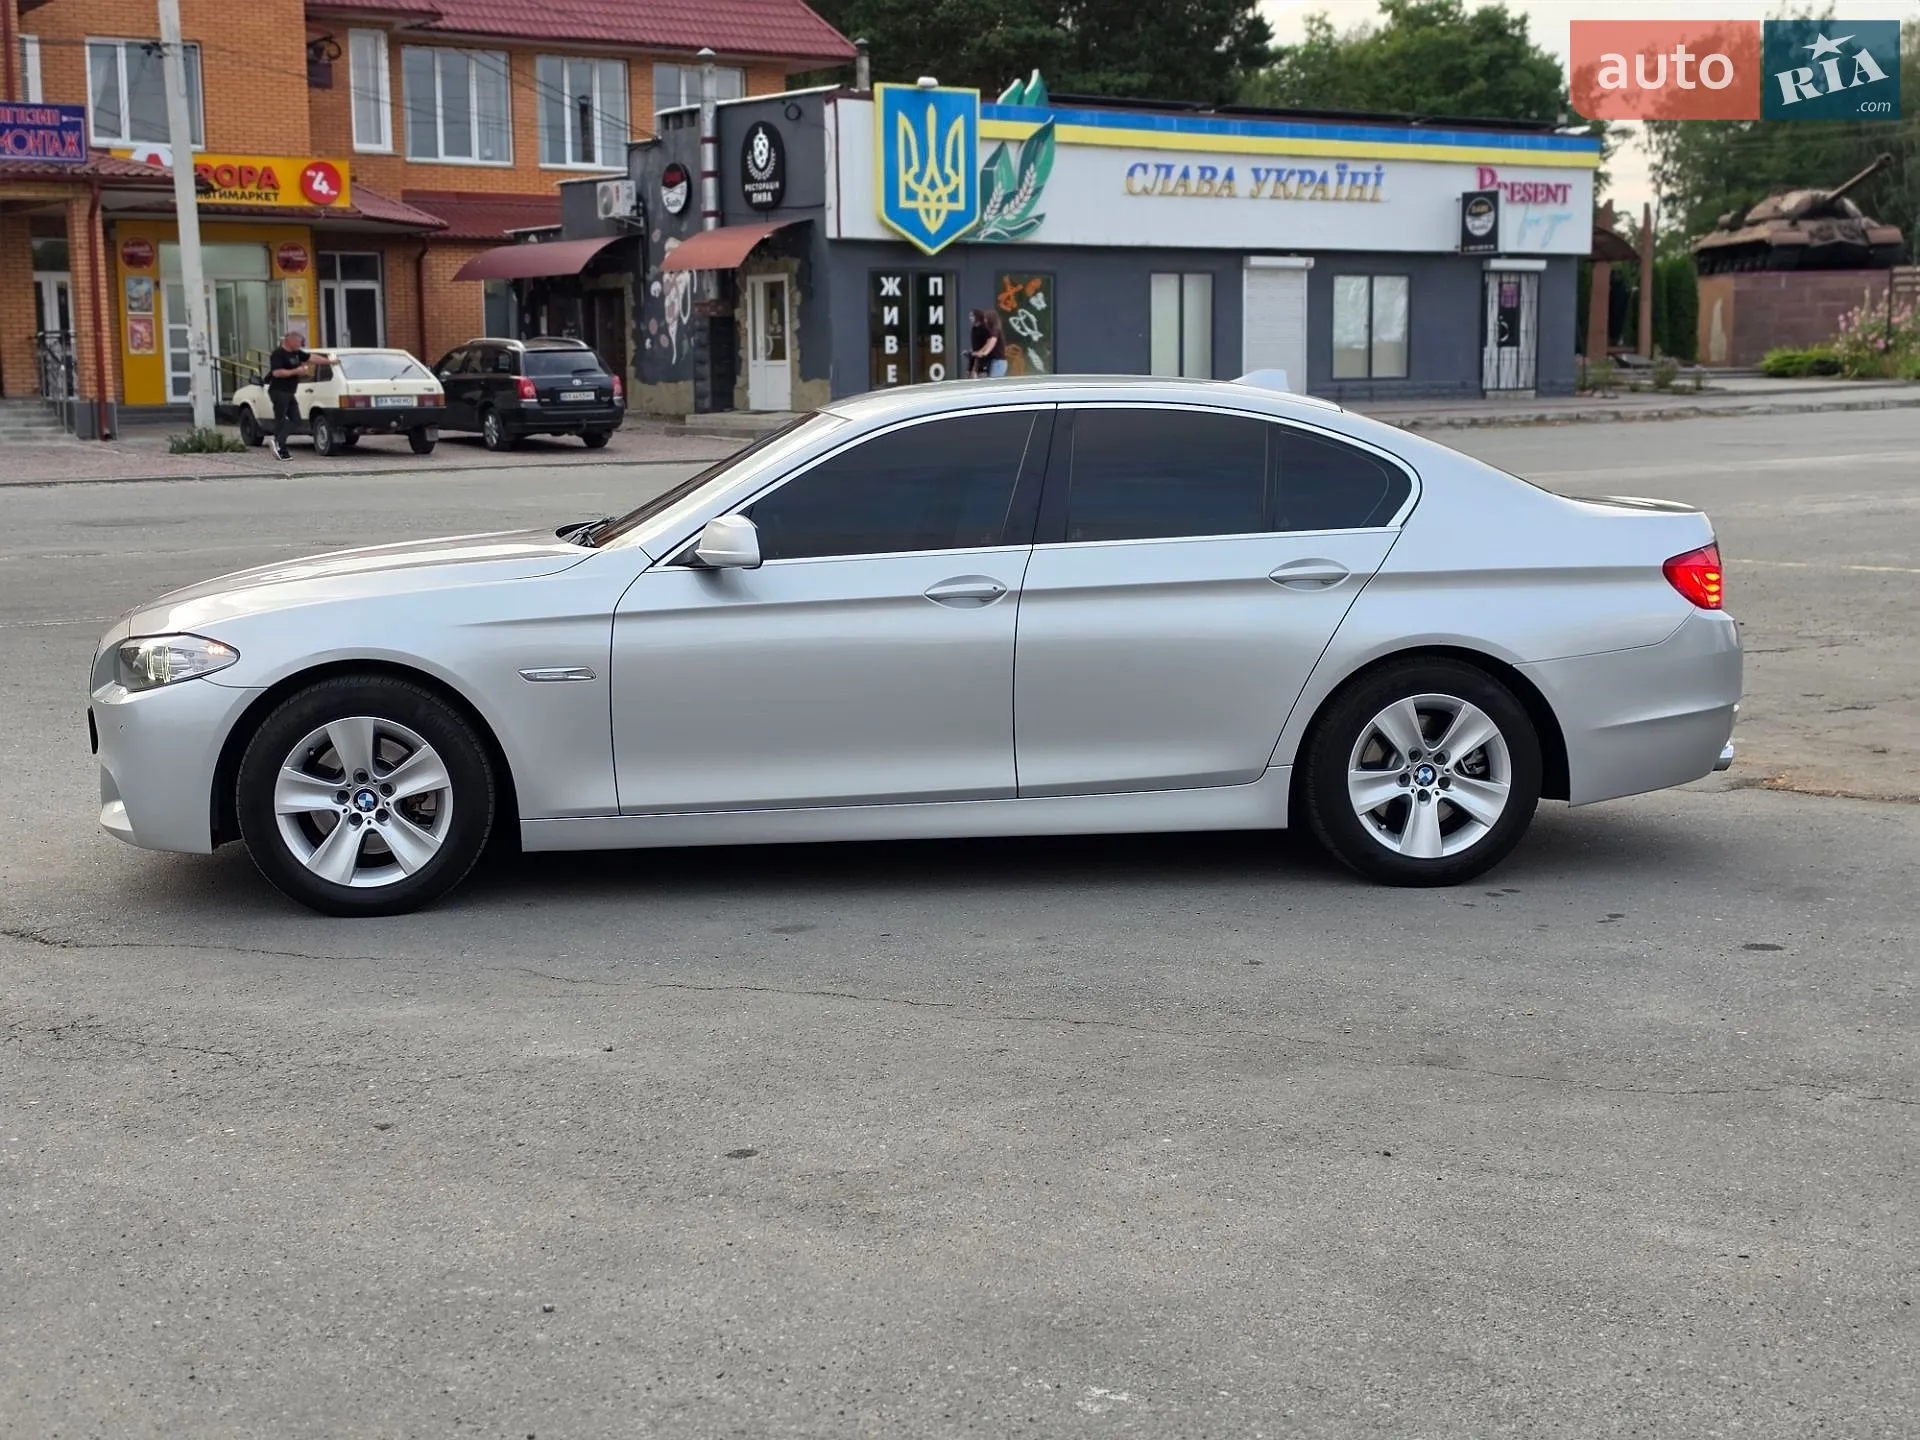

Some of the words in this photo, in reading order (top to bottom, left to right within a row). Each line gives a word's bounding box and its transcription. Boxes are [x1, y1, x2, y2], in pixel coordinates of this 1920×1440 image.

[1124, 163, 1237, 197] СЛАВА
[1250, 163, 1385, 202] УКРАЇНІ
[880, 276, 902, 383] ЖИВЕ
[929, 276, 945, 381] ПИВО
